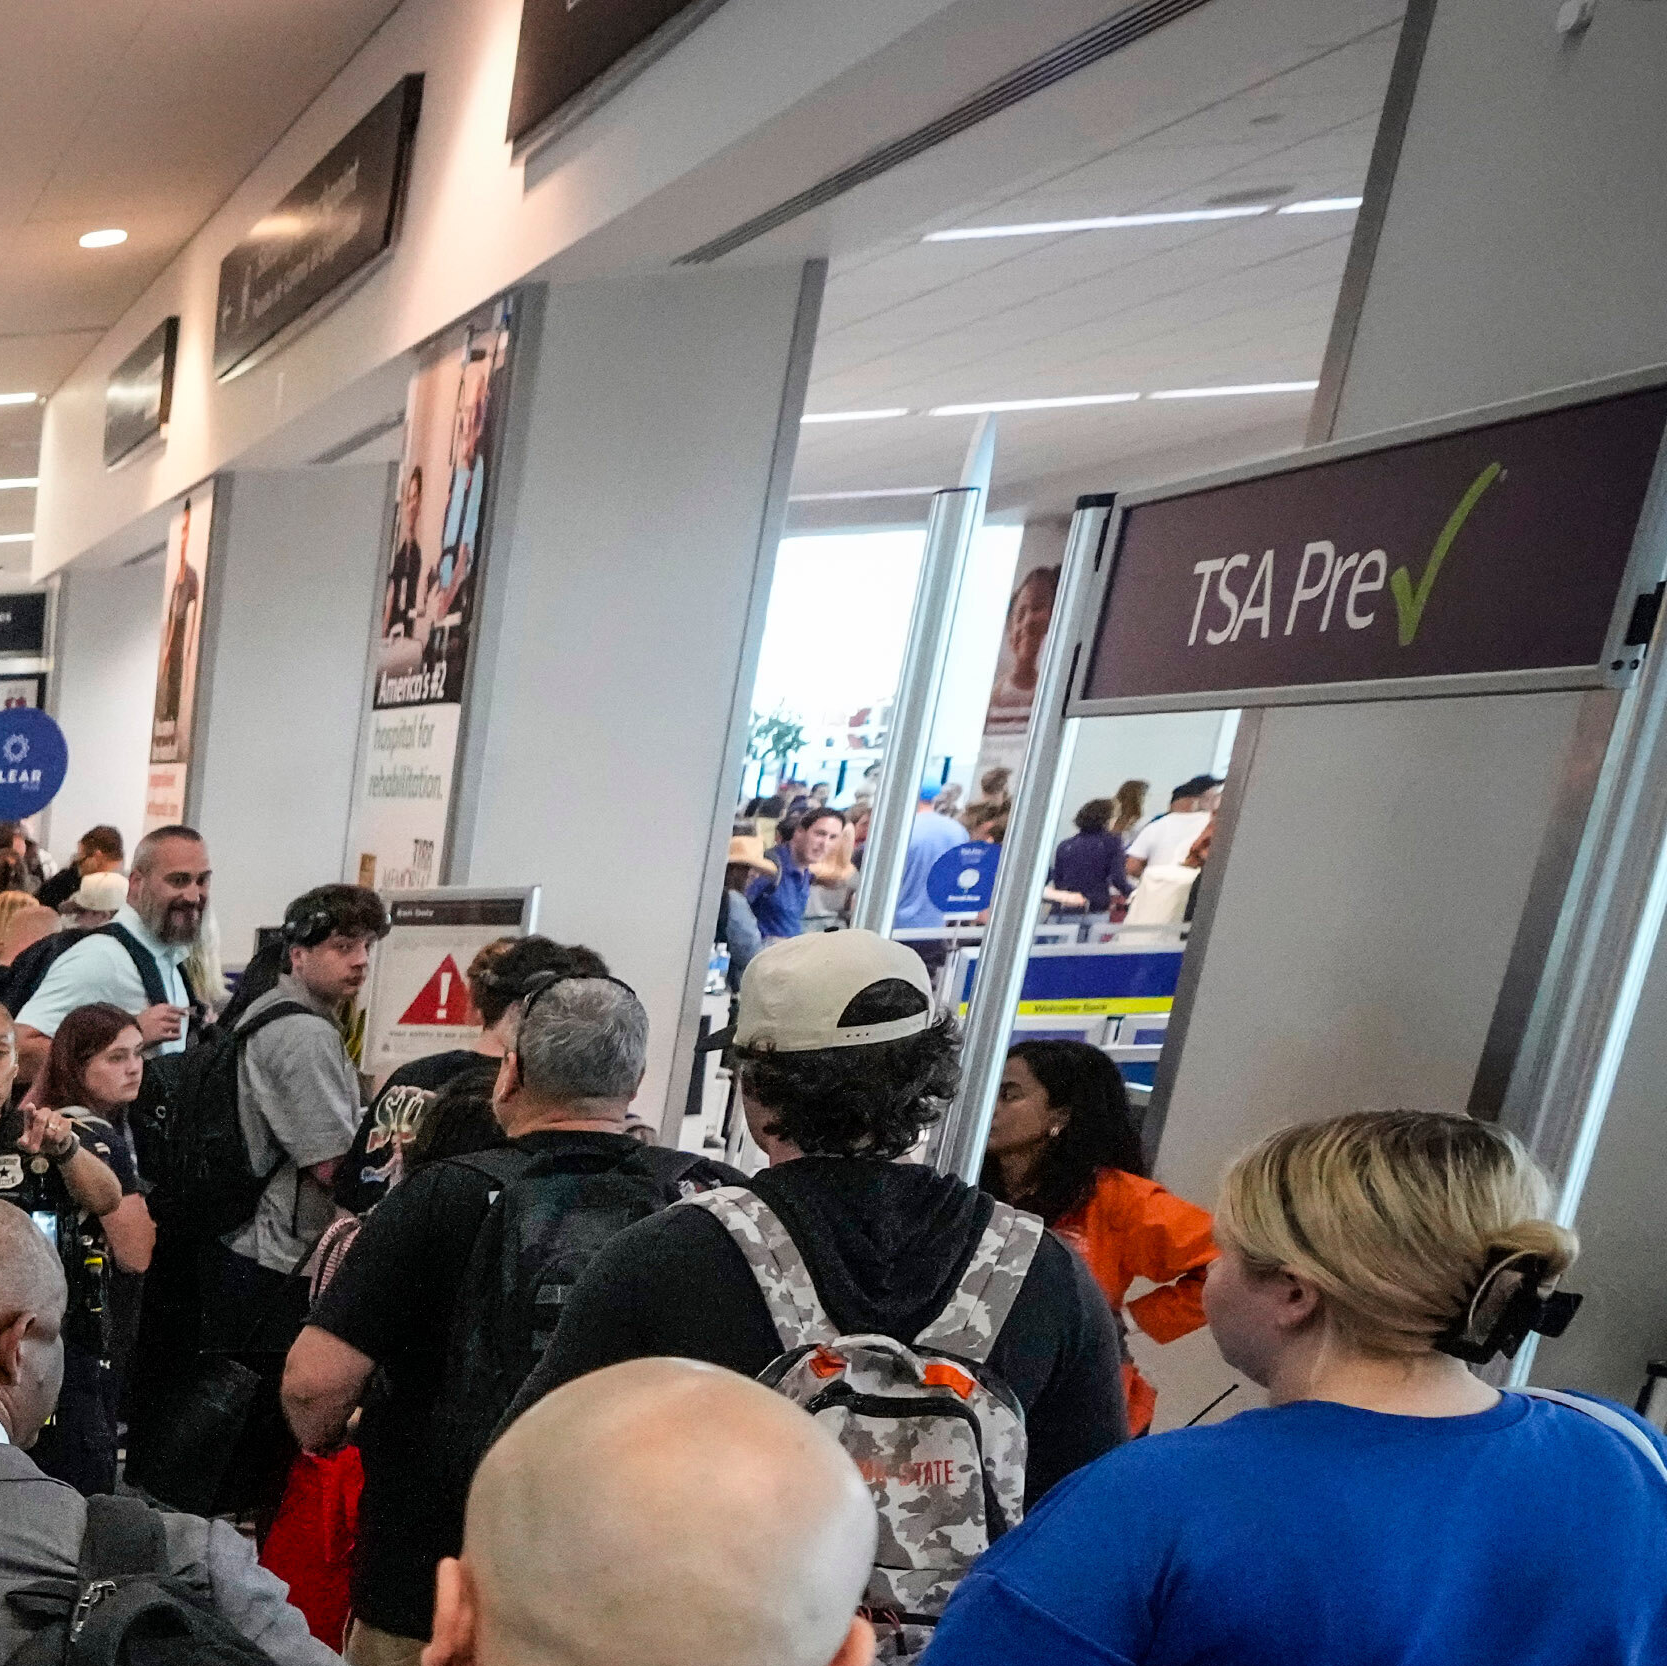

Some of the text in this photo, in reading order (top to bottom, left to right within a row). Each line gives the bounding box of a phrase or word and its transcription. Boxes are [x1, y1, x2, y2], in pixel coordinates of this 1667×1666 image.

[1187, 540, 1387, 646] TSA Pre
[377, 664, 430, 704] America's
